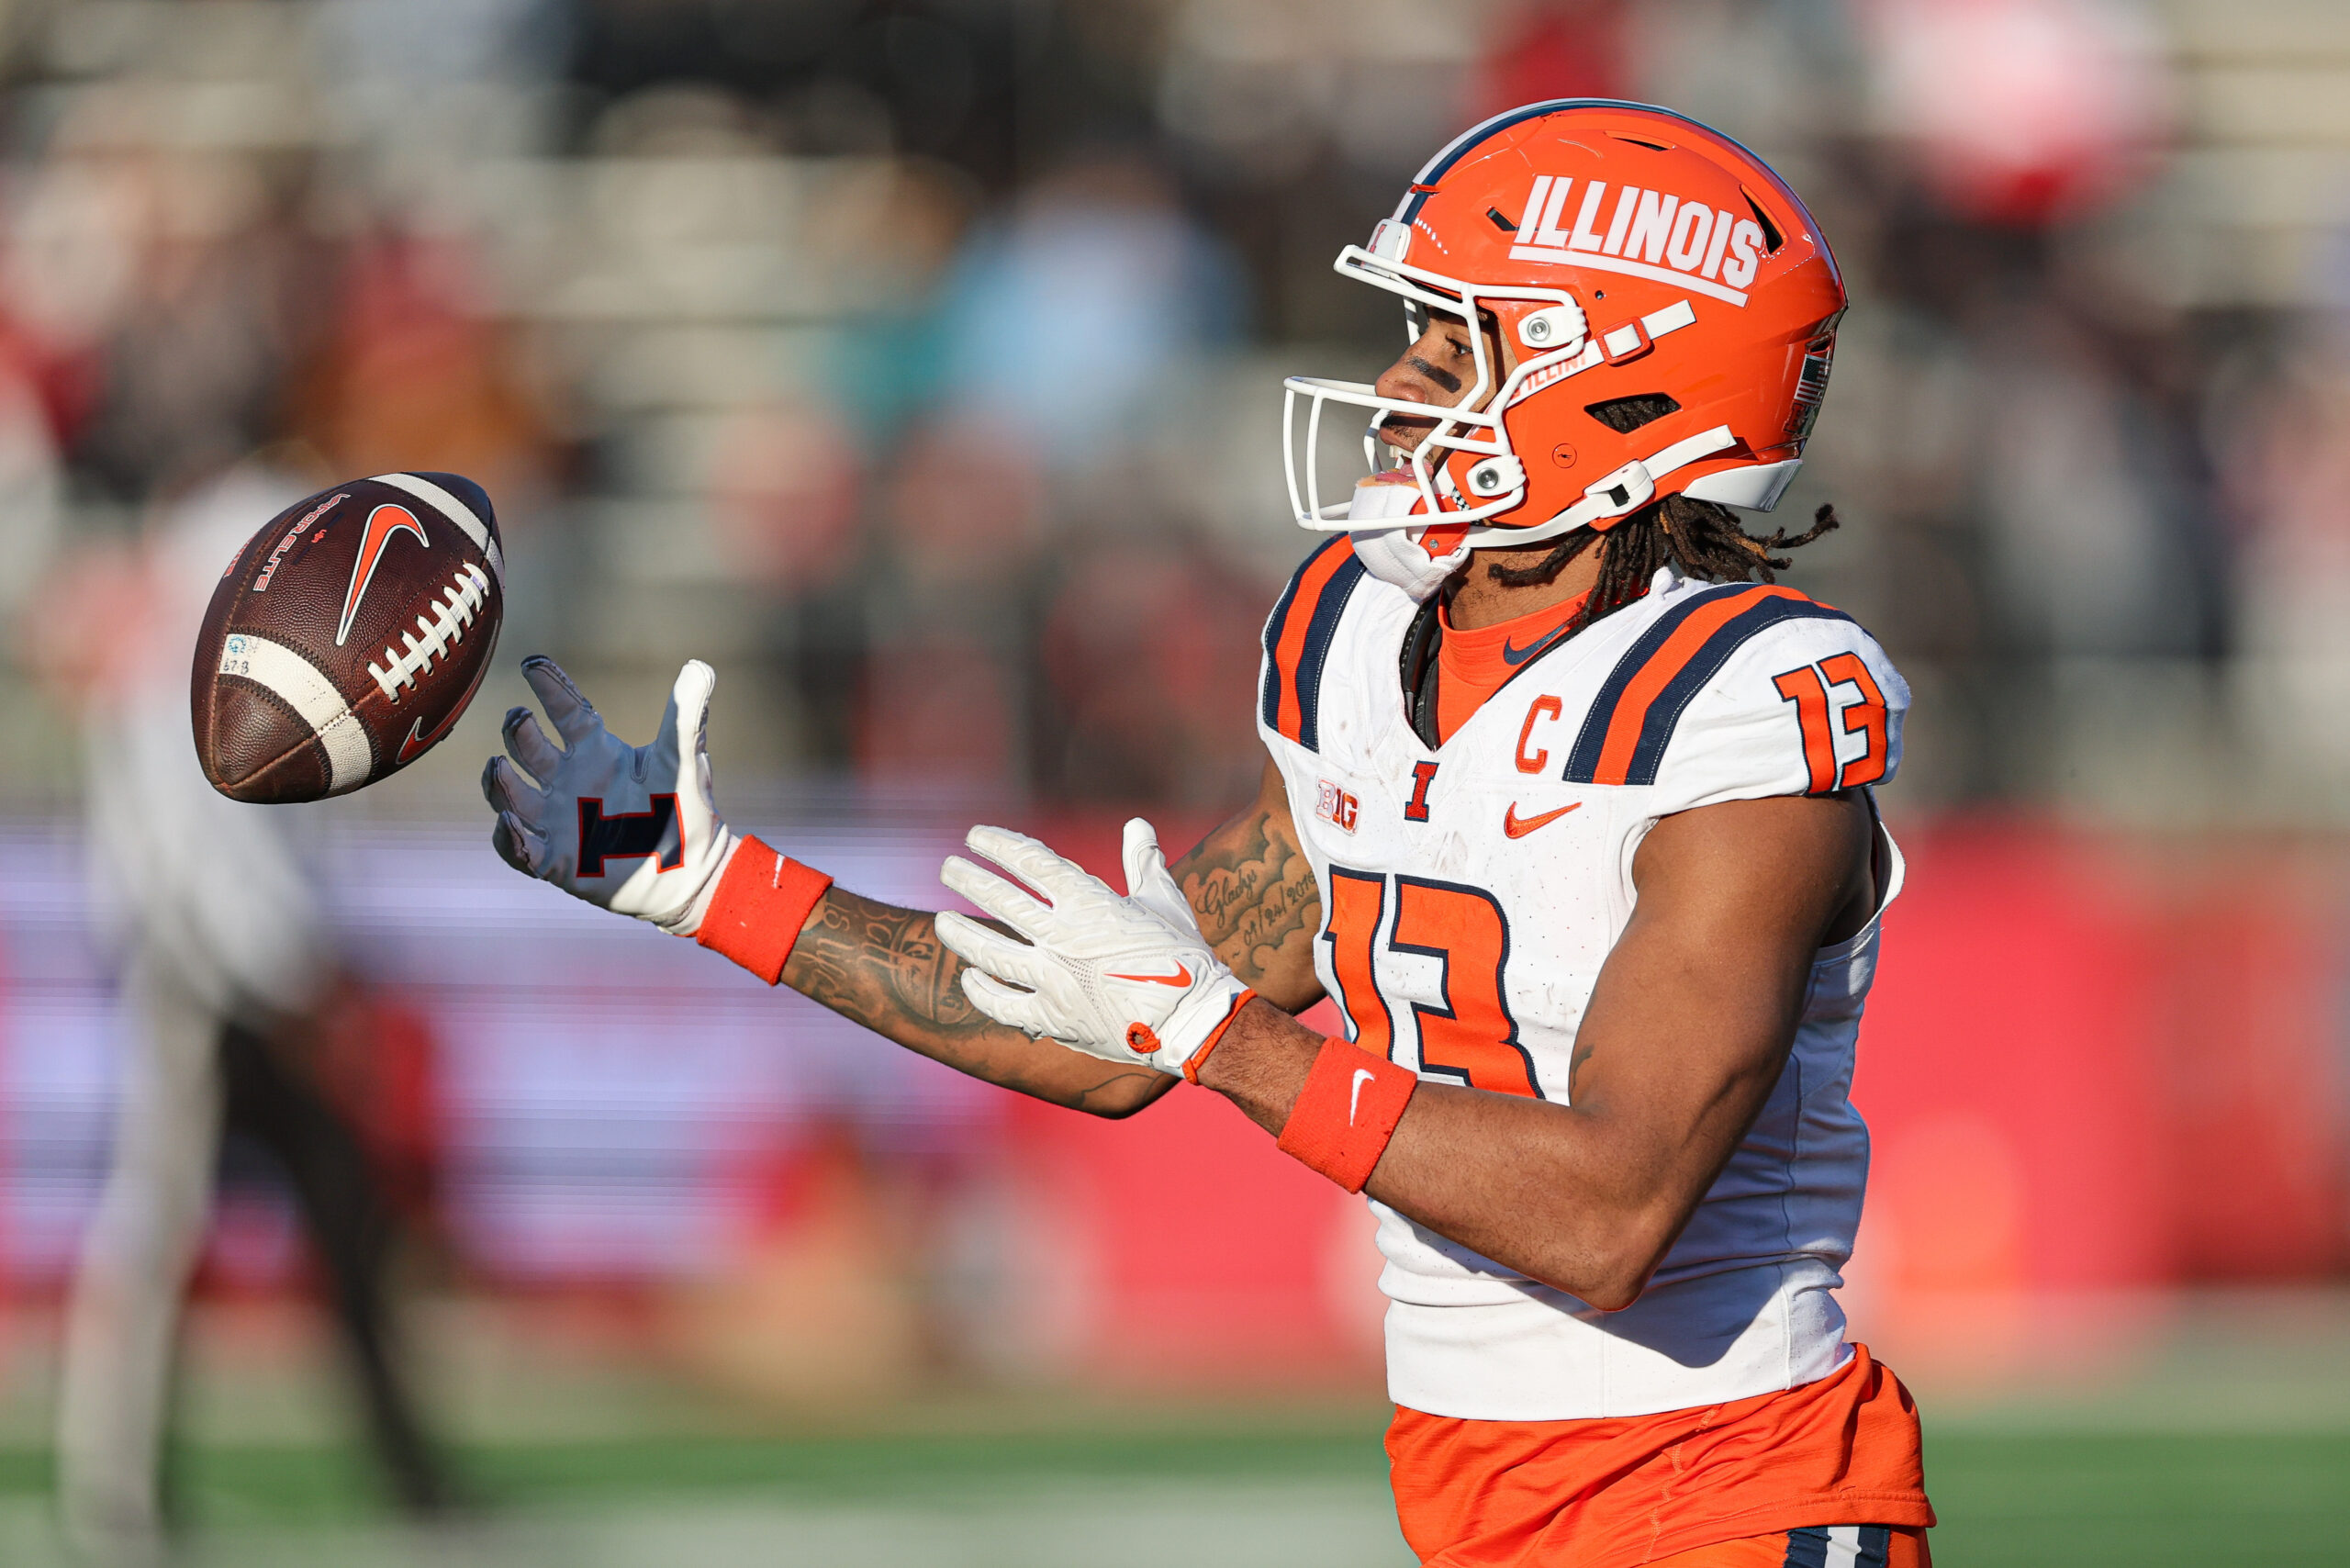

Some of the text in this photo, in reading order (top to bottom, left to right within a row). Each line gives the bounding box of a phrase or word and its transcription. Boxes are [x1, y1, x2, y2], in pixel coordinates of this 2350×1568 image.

[1514, 174, 1762, 290] ILLINOIS
[252, 534, 297, 591] ELITE
[1516, 694, 1562, 775] C
[1771, 650, 1888, 798] 13
[1404, 760, 1440, 823] I
[1195, 868, 1258, 929] Gladys
[1322, 863, 1547, 1101] 13
